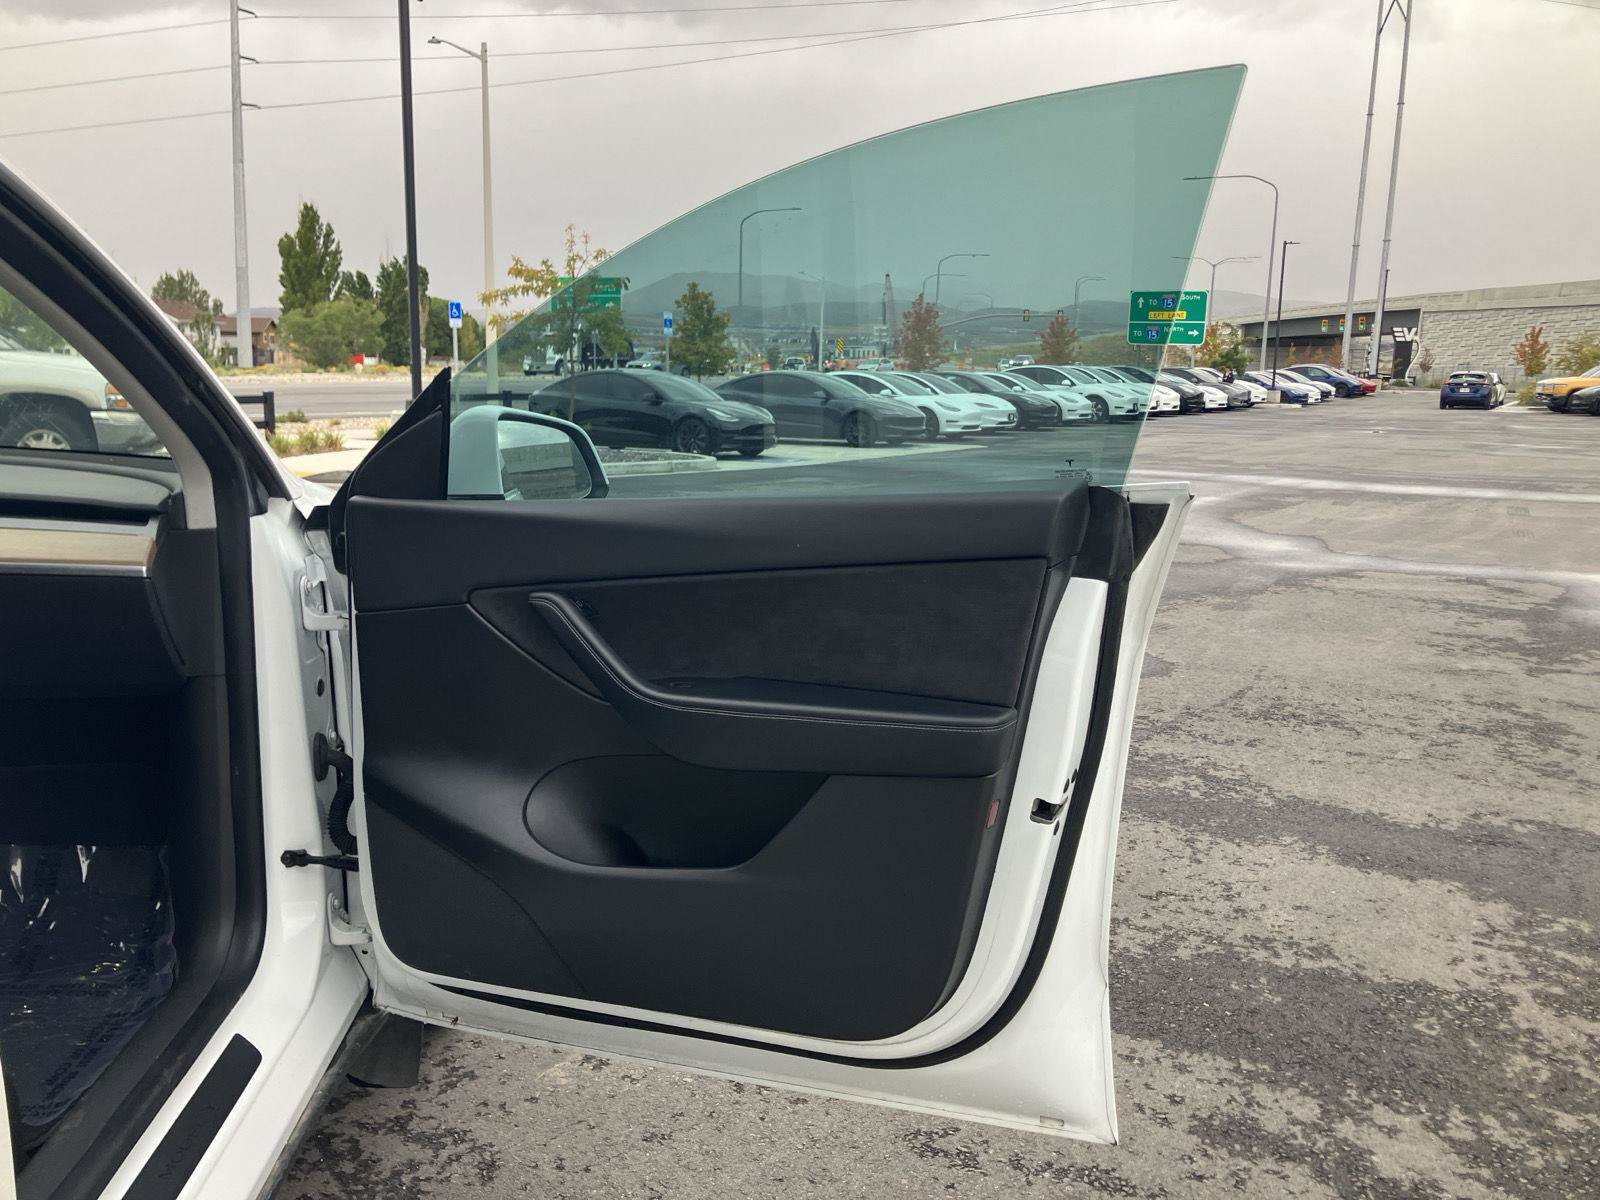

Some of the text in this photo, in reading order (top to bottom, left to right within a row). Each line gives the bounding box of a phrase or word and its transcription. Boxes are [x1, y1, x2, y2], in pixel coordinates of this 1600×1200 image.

[1163, 299, 1173, 308] 15
[1148, 330, 1158, 340] 15
[1392, 327, 1418, 341] EV
